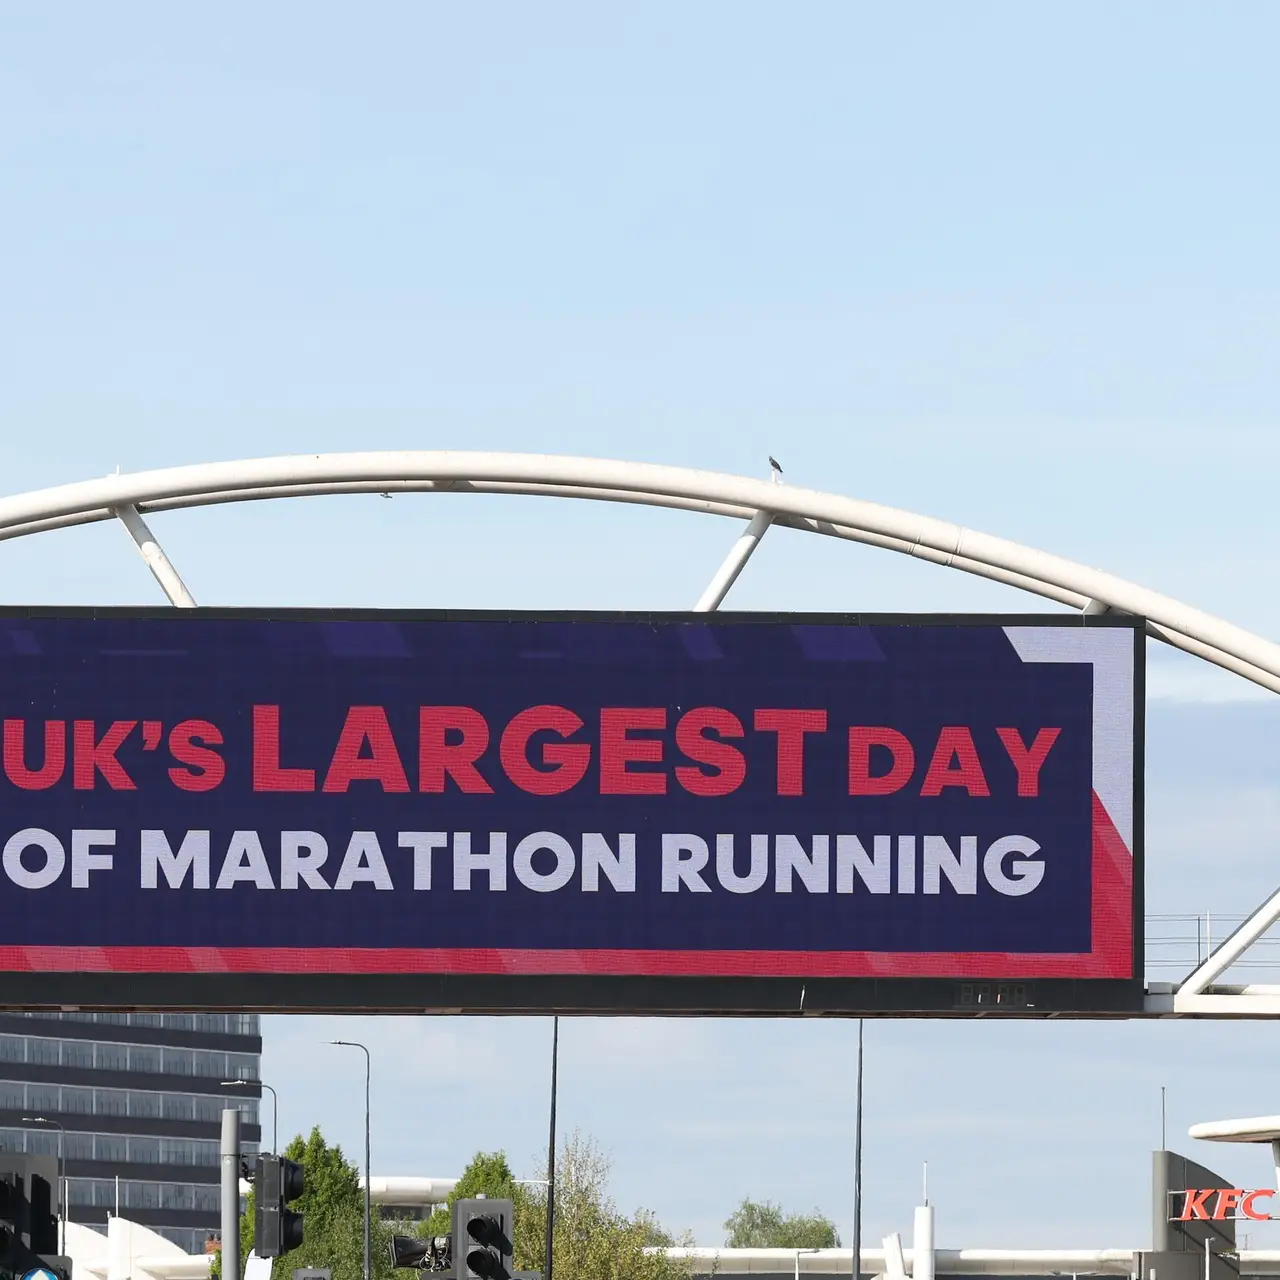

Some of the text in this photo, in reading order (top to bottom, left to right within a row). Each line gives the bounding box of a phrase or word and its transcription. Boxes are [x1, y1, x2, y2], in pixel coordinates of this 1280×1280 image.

[252, 704, 827, 796] LARGEST
[849, 725, 1062, 797] DAY
[2, 827, 1046, 896] OF MARATHON RUNNING
[1180, 1189, 1275, 1221] KFC
